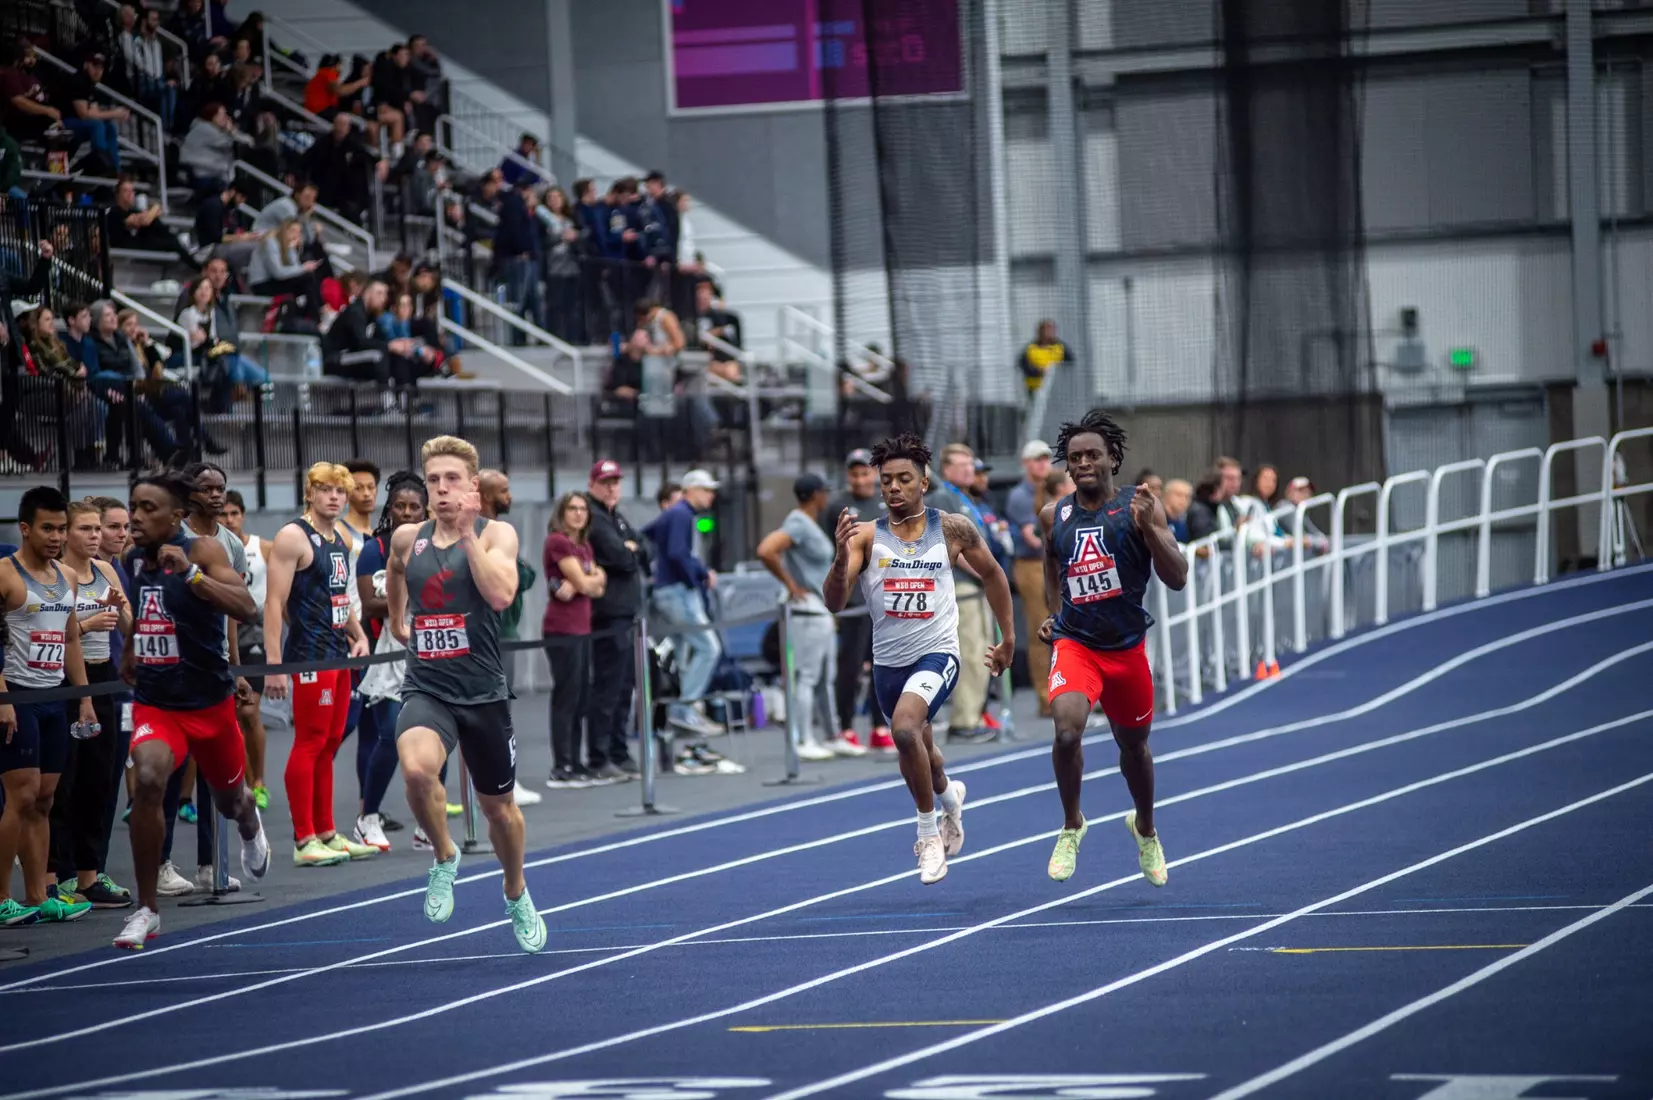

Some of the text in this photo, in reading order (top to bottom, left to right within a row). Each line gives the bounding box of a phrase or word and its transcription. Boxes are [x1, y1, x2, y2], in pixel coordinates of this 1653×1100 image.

[1074, 561, 1105, 573] WSU OPEN
[1076, 571, 1112, 596] 145
[892, 592, 927, 611] 778
[139, 636, 169, 656] 140
[424, 630, 459, 650] 885
[37, 644, 62, 661] 772
